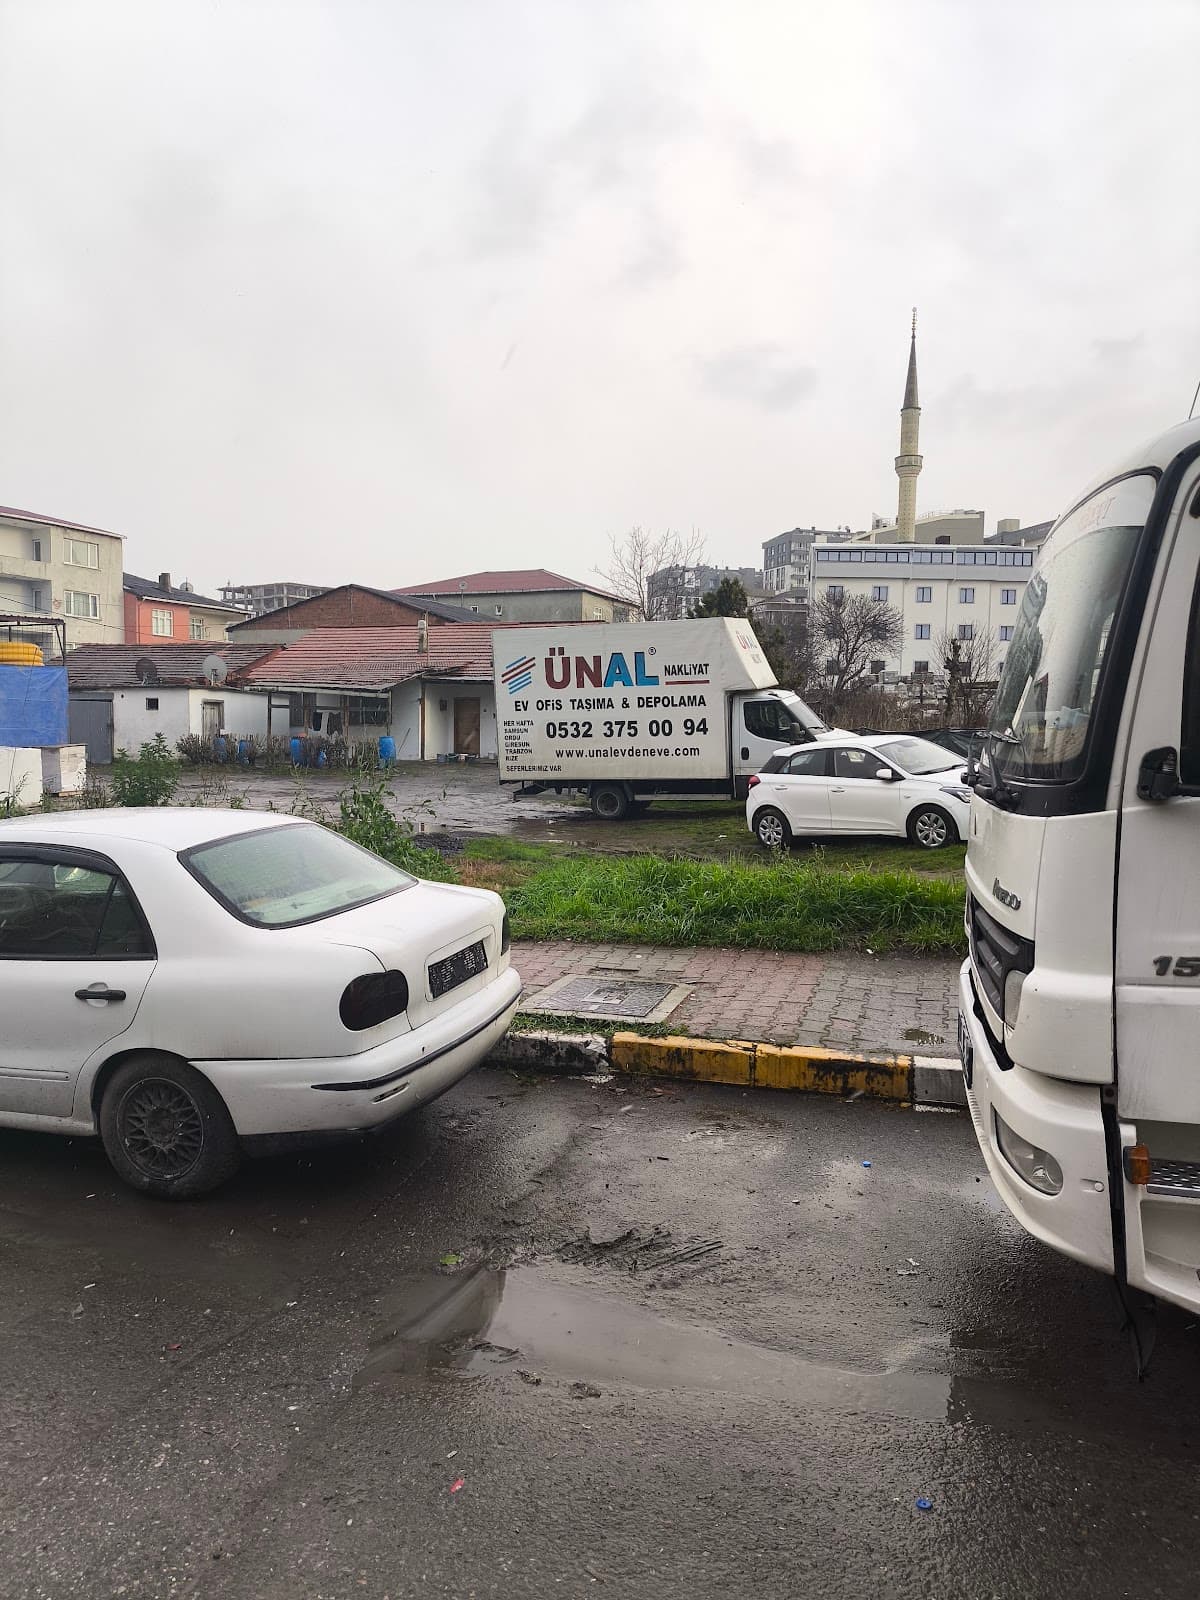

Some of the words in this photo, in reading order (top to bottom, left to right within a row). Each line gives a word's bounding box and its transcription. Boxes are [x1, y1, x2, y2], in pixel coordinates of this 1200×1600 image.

[544, 646, 660, 690] ÜNAL
[514, 700, 529, 712] EV
[569, 697, 615, 712] TAŞIMA
[621, 697, 630, 709] &
[637, 694, 707, 708] DEPOLAMA
[546, 721, 593, 739] 0532
[602, 720, 638, 738] 375
[649, 719, 673, 737] 00
[683, 717, 709, 736] 94
[555, 746, 700, 758] www.unalevdeneve.com
[1152, 955, 1200, 978] 15
